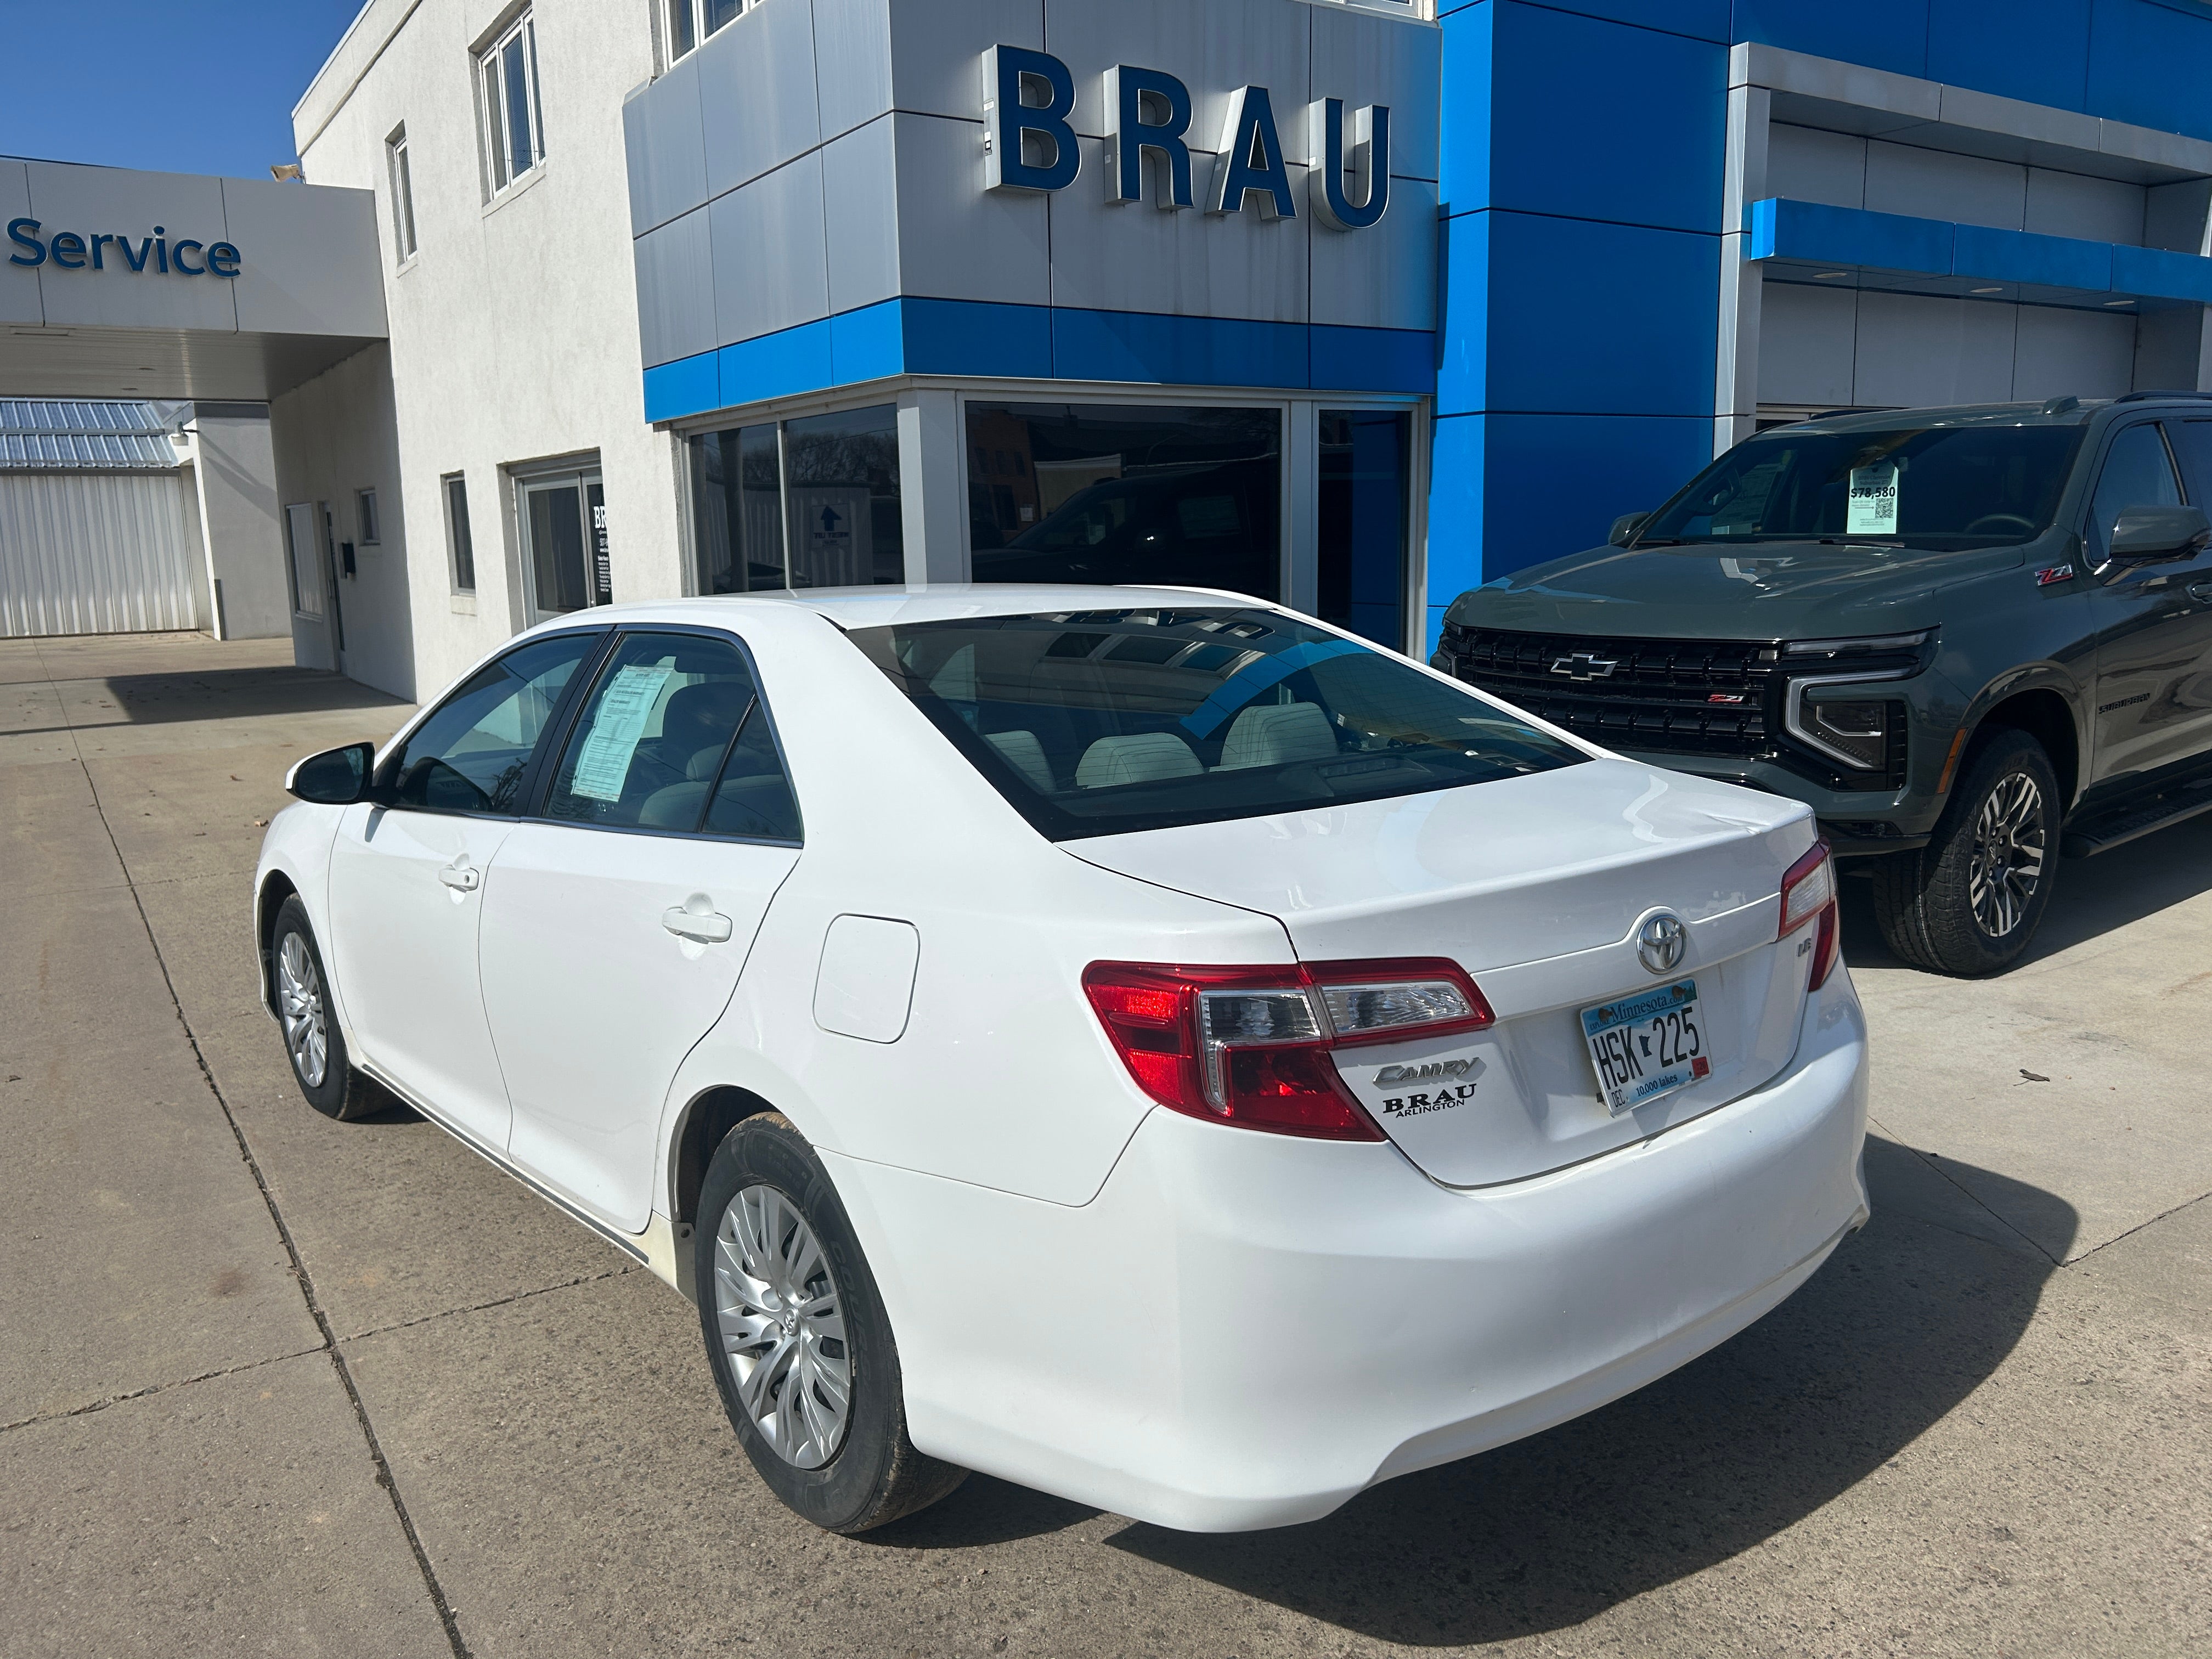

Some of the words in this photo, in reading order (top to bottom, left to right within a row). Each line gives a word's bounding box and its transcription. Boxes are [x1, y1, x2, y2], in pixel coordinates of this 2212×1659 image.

[981, 44, 1391, 232] BRAU
[7, 217, 242, 278] Service
[1850, 486, 1895, 499] $78,580
[2035, 564, 2073, 586] Z71
[1707, 694, 1745, 704] Z71
[2098, 692, 2151, 714] SUBURBAN
[1592, 1026, 1644, 1090] HSK
[1652, 1006, 1700, 1068] 225
[1372, 1057, 1480, 1084] CAMRY
[1635, 1080, 1658, 1097] 10,000
[1659, 1074, 1678, 1090] lakes
[1382, 1083, 1477, 1114] BRAU
[1395, 1098, 1465, 1119] ARLINGTON
[1611, 1089, 1626, 1108] DEC
